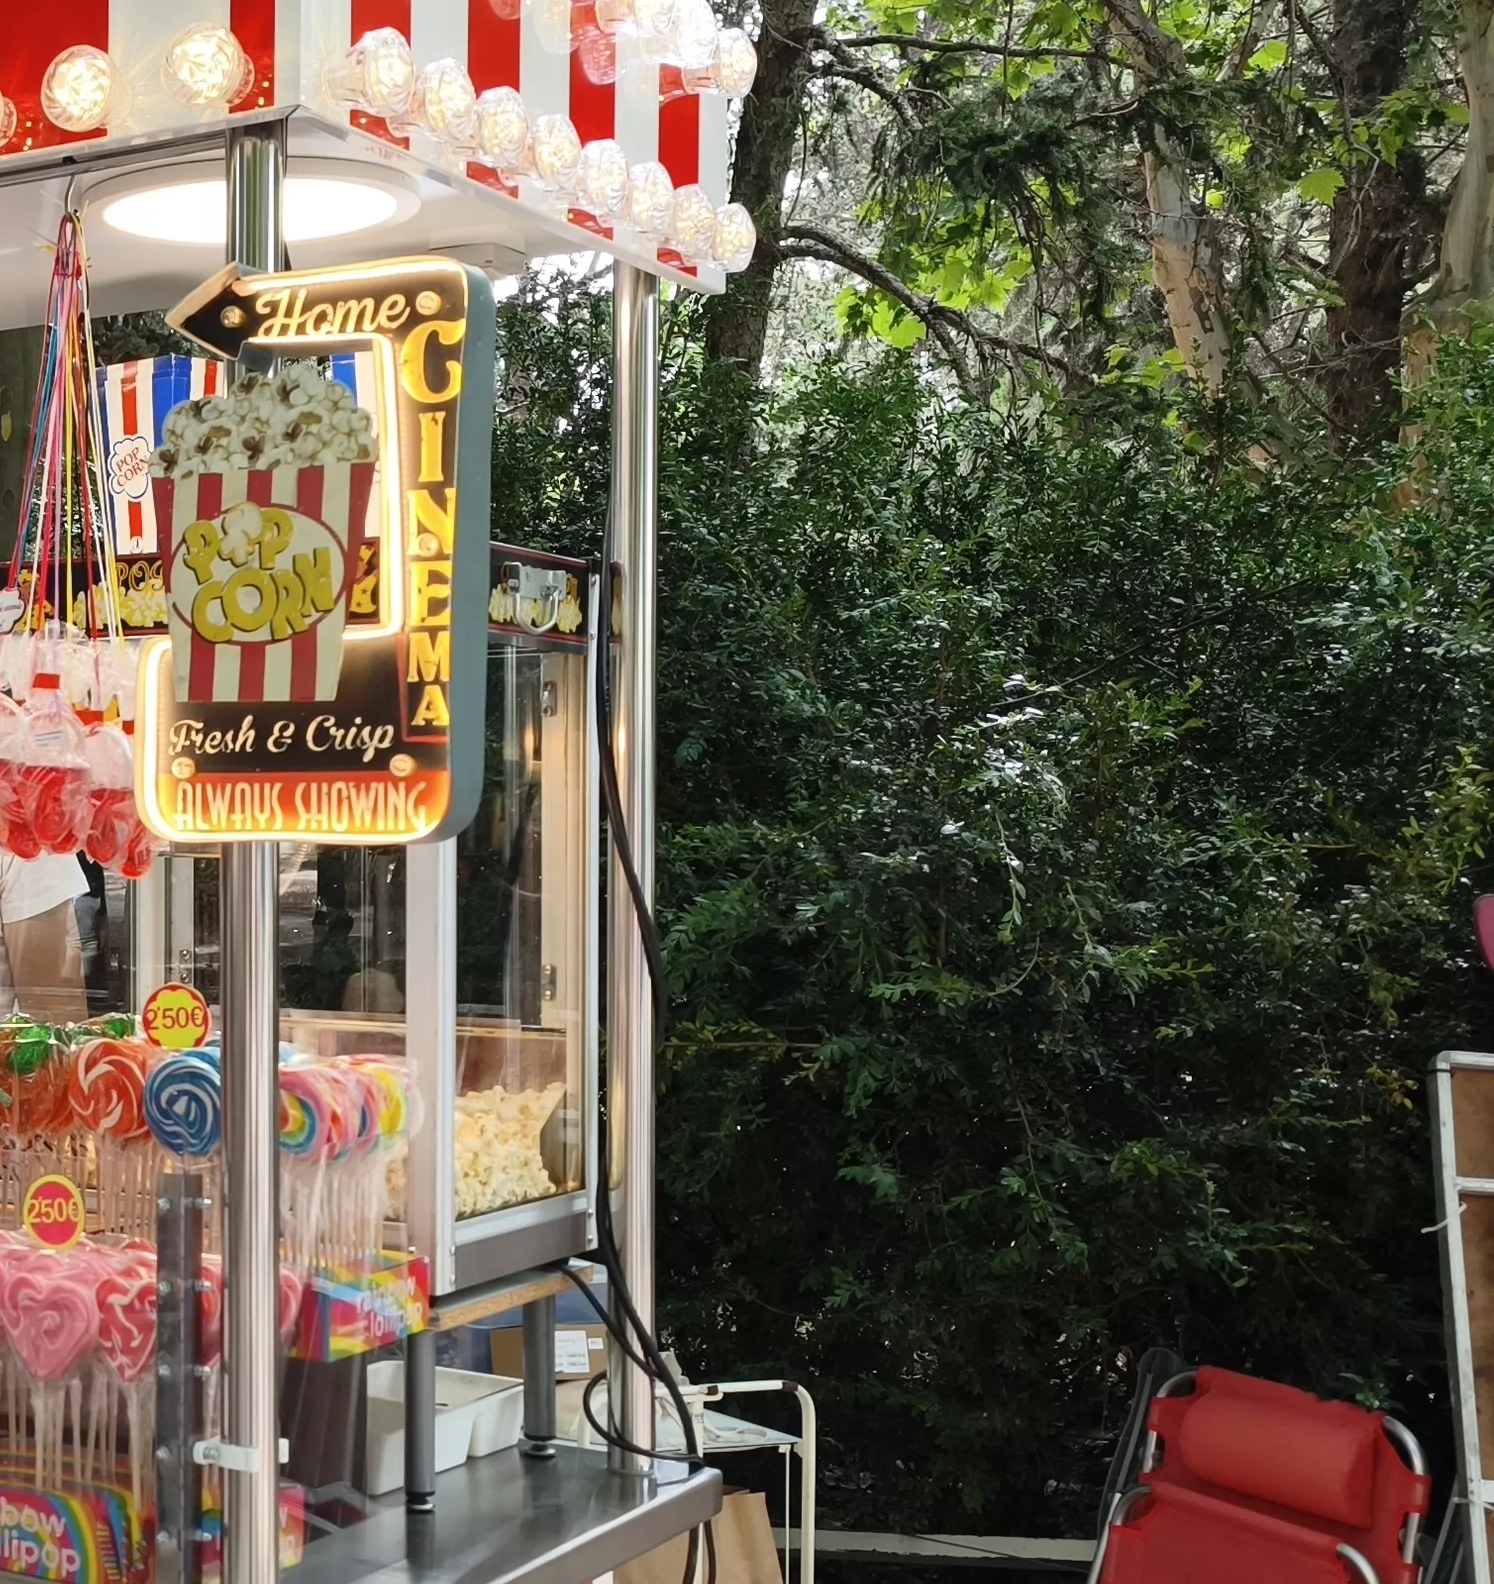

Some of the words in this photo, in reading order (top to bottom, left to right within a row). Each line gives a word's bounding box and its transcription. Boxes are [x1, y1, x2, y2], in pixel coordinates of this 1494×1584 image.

[256, 287, 411, 339] Home
[116, 447, 140, 472] POP
[116, 454, 150, 487] CORN
[400, 318, 466, 727] CINEMA
[191, 546, 335, 643] CORN
[168, 714, 256, 756] Fresh
[267, 720, 296, 753] &
[306, 714, 395, 763] Crisp
[173, 778, 283, 831] ALWAYS
[295, 781, 429, 832] SHOWING
